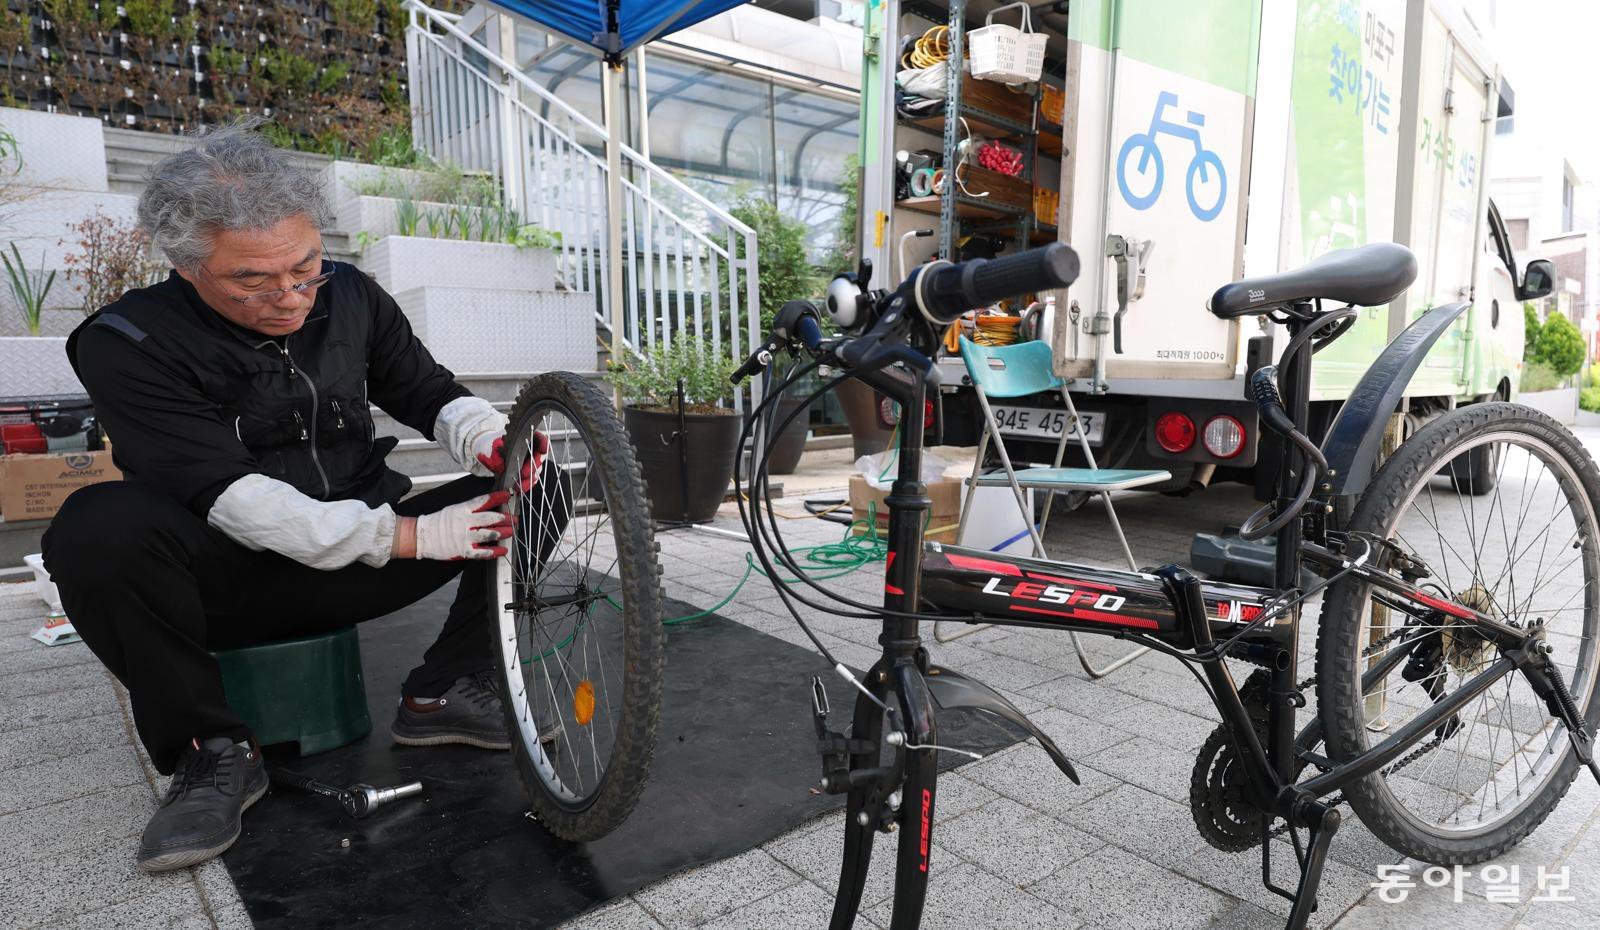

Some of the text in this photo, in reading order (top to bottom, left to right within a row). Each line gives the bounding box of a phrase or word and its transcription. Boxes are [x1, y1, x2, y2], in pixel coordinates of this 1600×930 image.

[1365, 11, 1395, 72] 마포구
[1329, 42, 1390, 134] 찾아가는
[981, 577, 1126, 612] LESPO
[919, 788, 931, 872] LESPO
